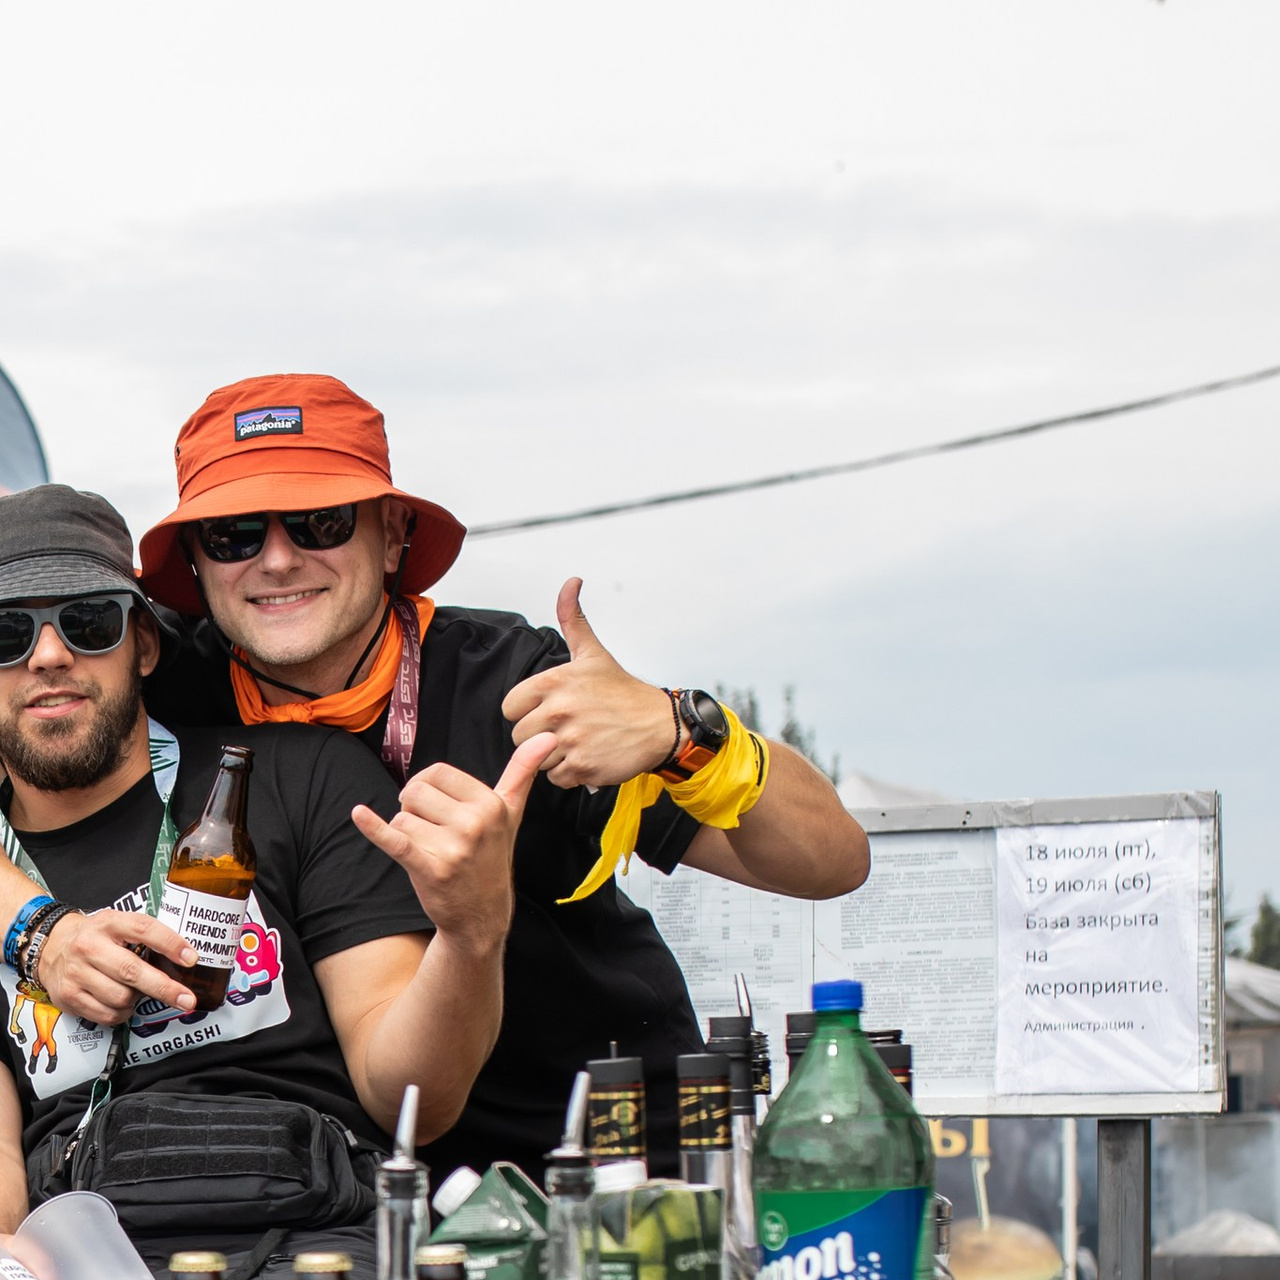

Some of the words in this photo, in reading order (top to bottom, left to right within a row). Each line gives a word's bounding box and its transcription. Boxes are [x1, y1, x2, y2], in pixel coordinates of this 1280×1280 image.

[240, 420, 292, 437] patagonia
[400, 662, 412, 704] ESTC
[399, 707, 417, 746] ESTC
[1026, 845, 1048, 861] 18
[1055, 846, 1107, 860] июля
[1115, 839, 1156, 861] (пт),
[1026, 877, 1047, 894] 19
[1055, 879, 1107, 893] июля
[1115, 872, 1151, 894] (сб)
[188, 904, 241, 926] HARDCORE
[1025, 913, 1070, 930] База
[1077, 912, 1158, 930] закрыта
[4, 909, 31, 966] ESTC
[185, 921, 228, 940] FRIENDS
[1025, 950, 1048, 962] на
[1025, 978, 1168, 998] мероприятие.
[1024, 1020, 1134, 1034] Администрация
[121, 1050, 142, 1069] HE
[142, 1023, 222, 1059] TORGASHI
